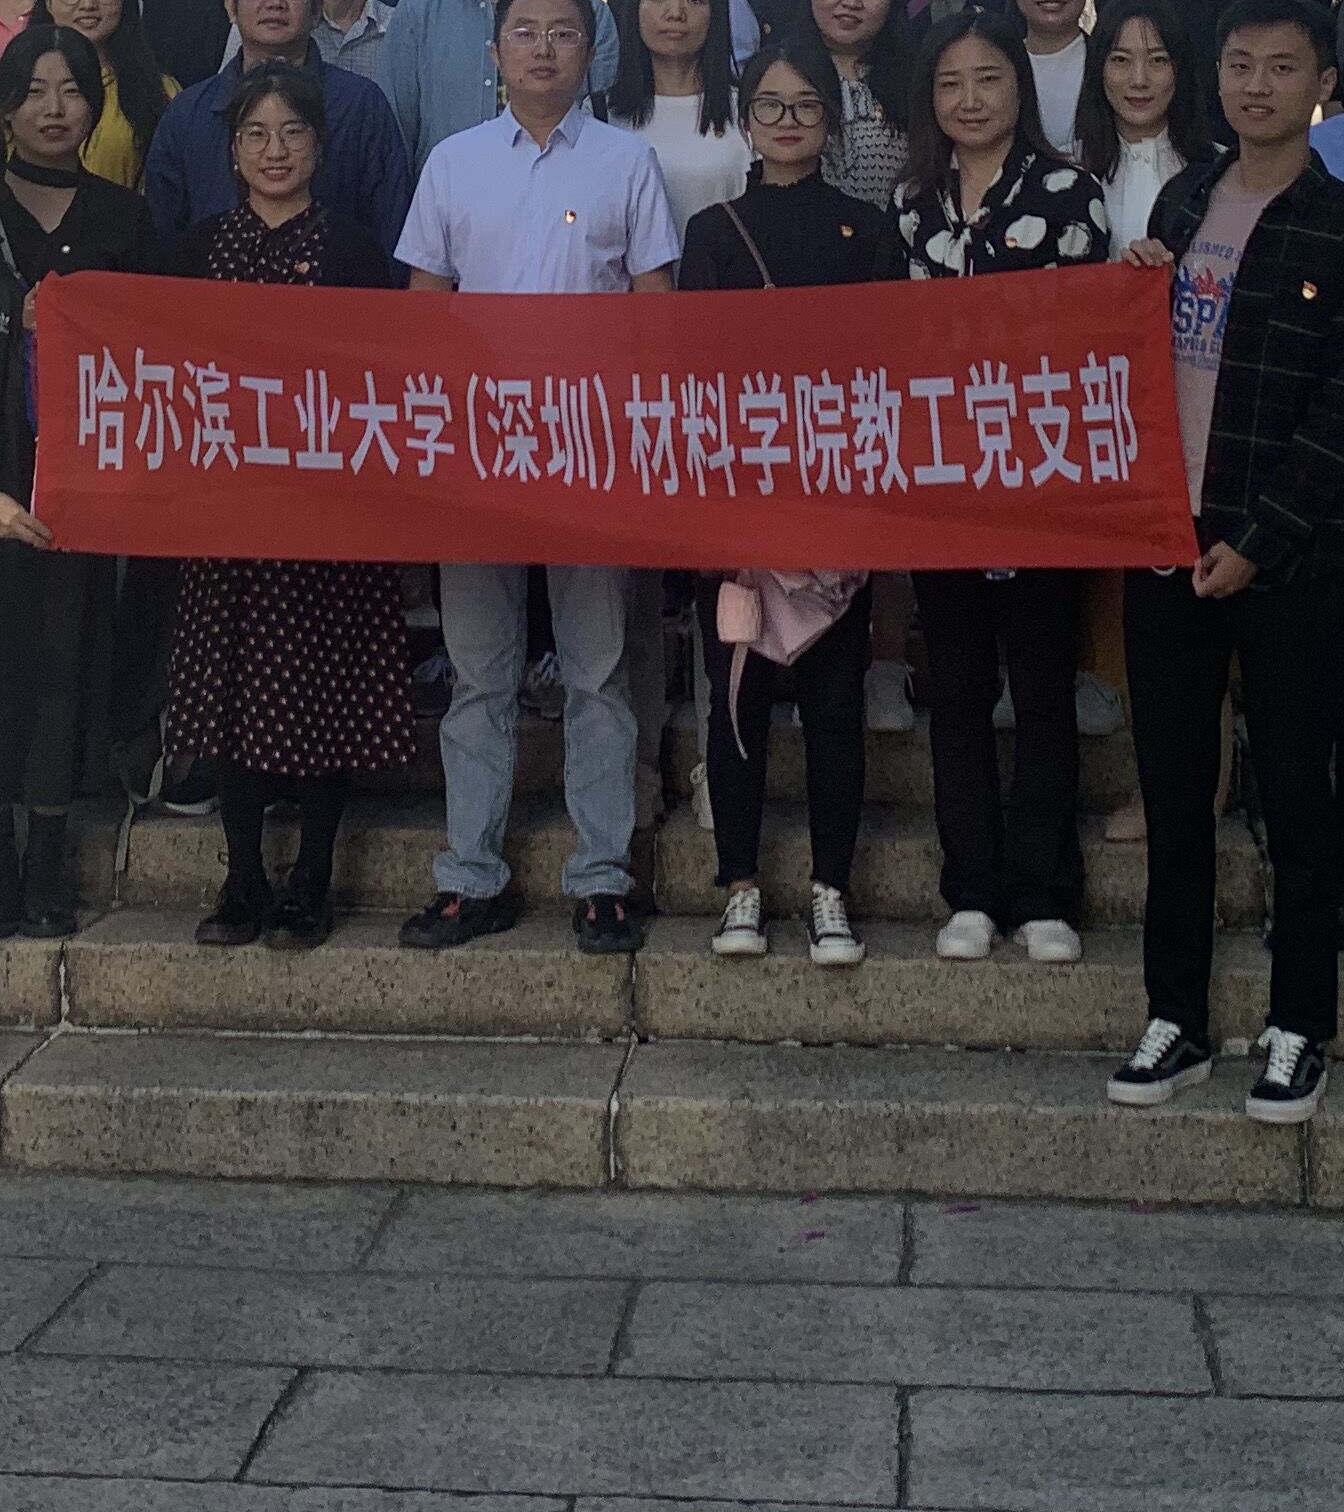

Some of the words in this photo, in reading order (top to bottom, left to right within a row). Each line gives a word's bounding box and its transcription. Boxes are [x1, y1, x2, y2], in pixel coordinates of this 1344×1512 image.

[77, 346, 1138, 497] 哈尔滨工业大学(深圳)材料学院教工党支部
